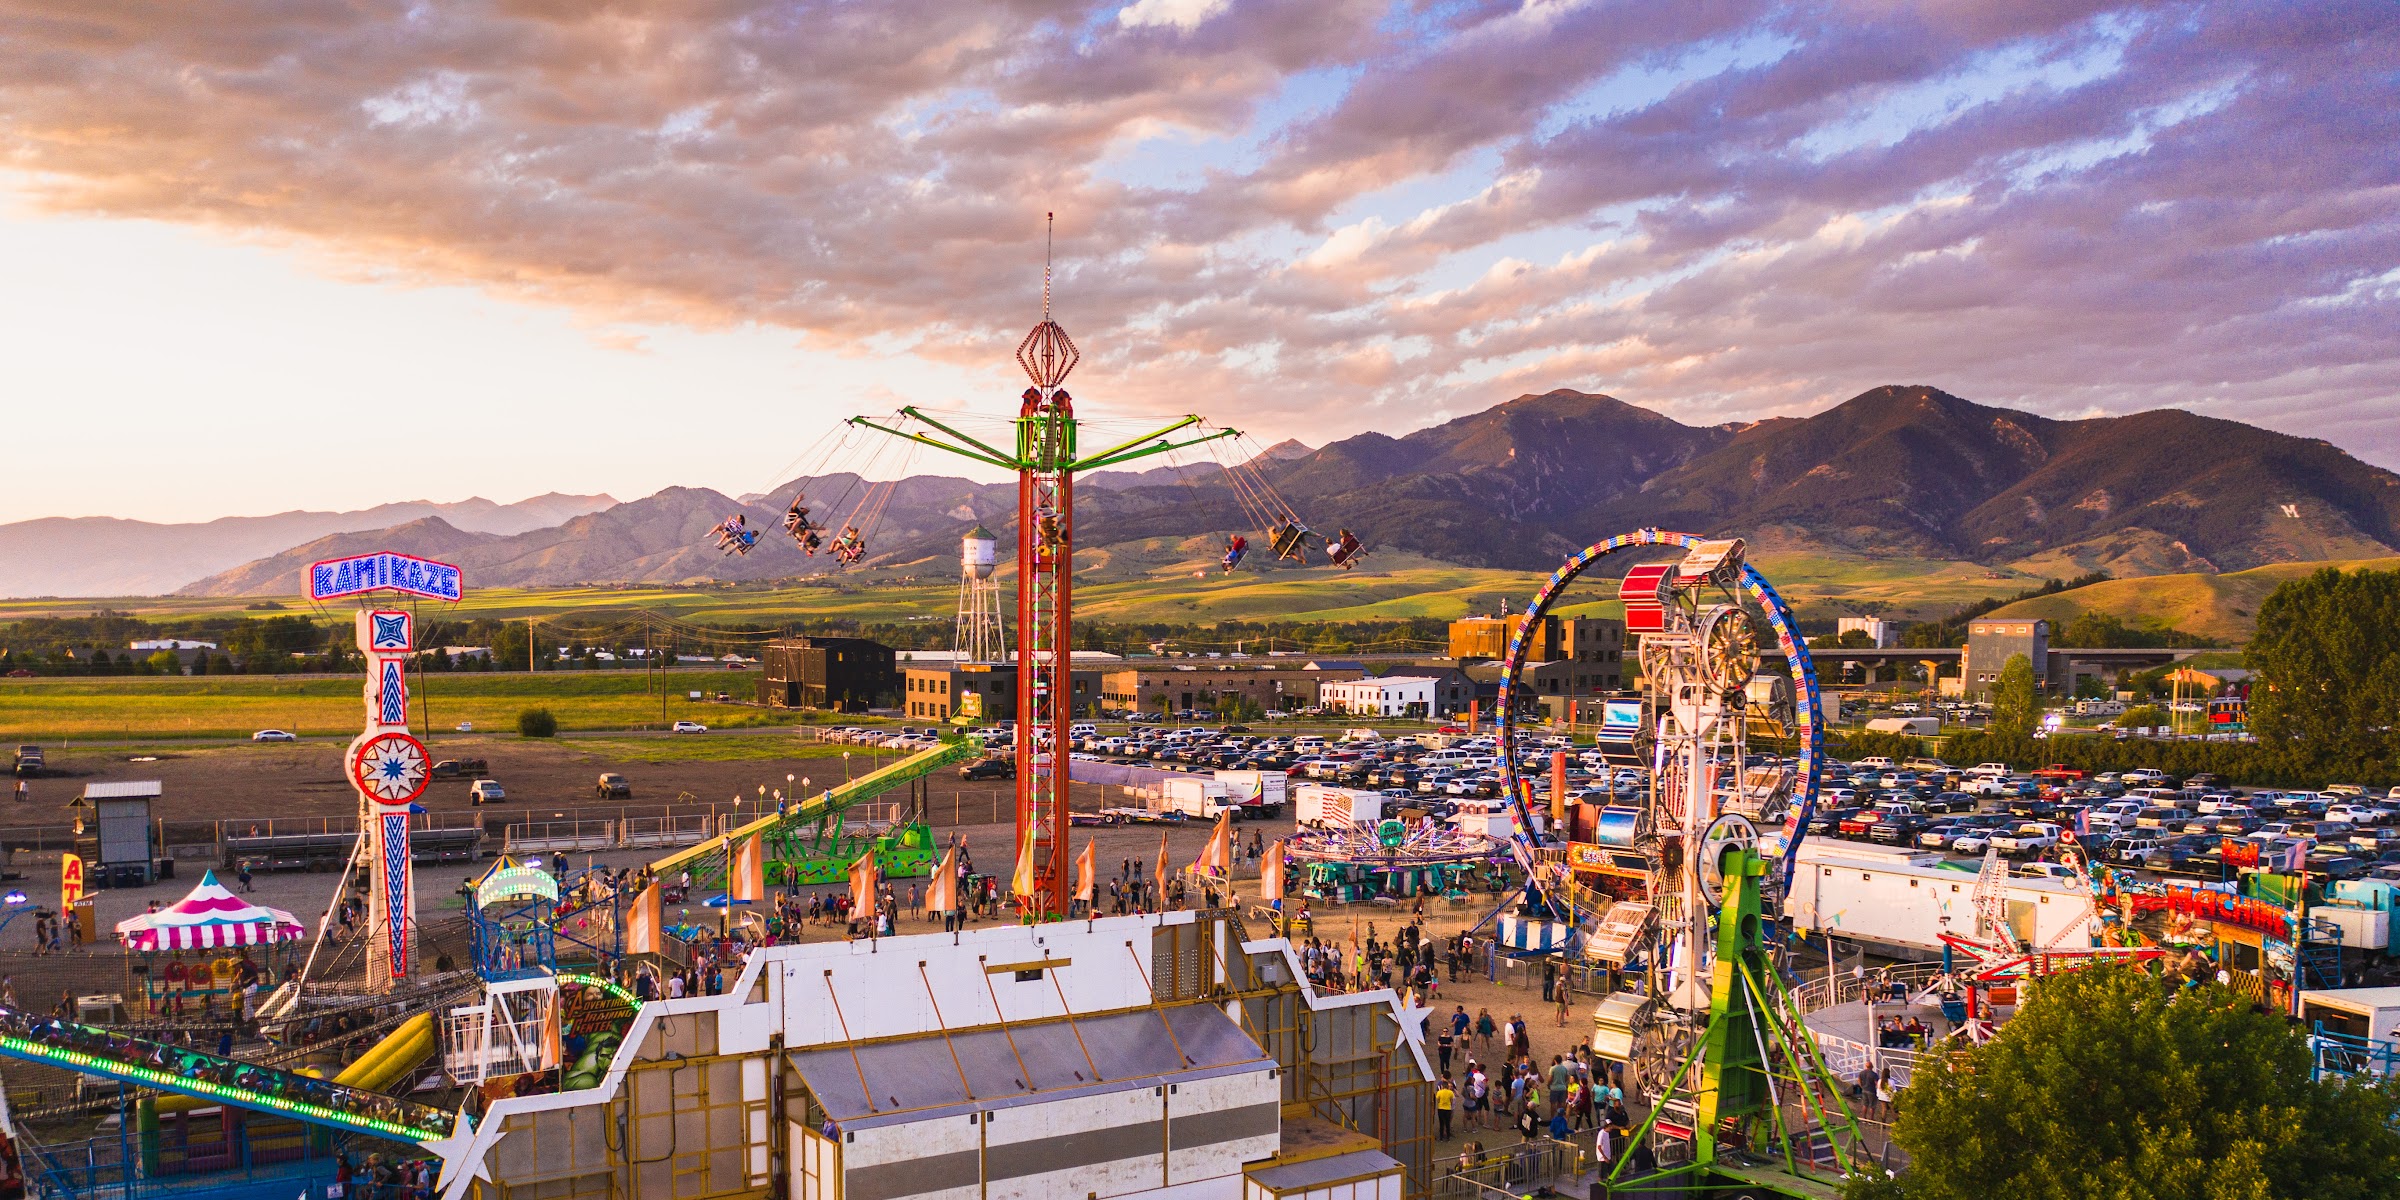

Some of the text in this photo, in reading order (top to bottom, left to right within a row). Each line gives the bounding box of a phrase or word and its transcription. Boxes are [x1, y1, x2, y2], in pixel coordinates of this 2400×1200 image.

[2280, 504, 2300, 518] M
[315, 555, 458, 597] KAMIKAZE
[2168, 884, 2286, 936] MACHINE
[583, 1009, 633, 1023] TRAINING
[569, 1018, 613, 1038] CENTER
